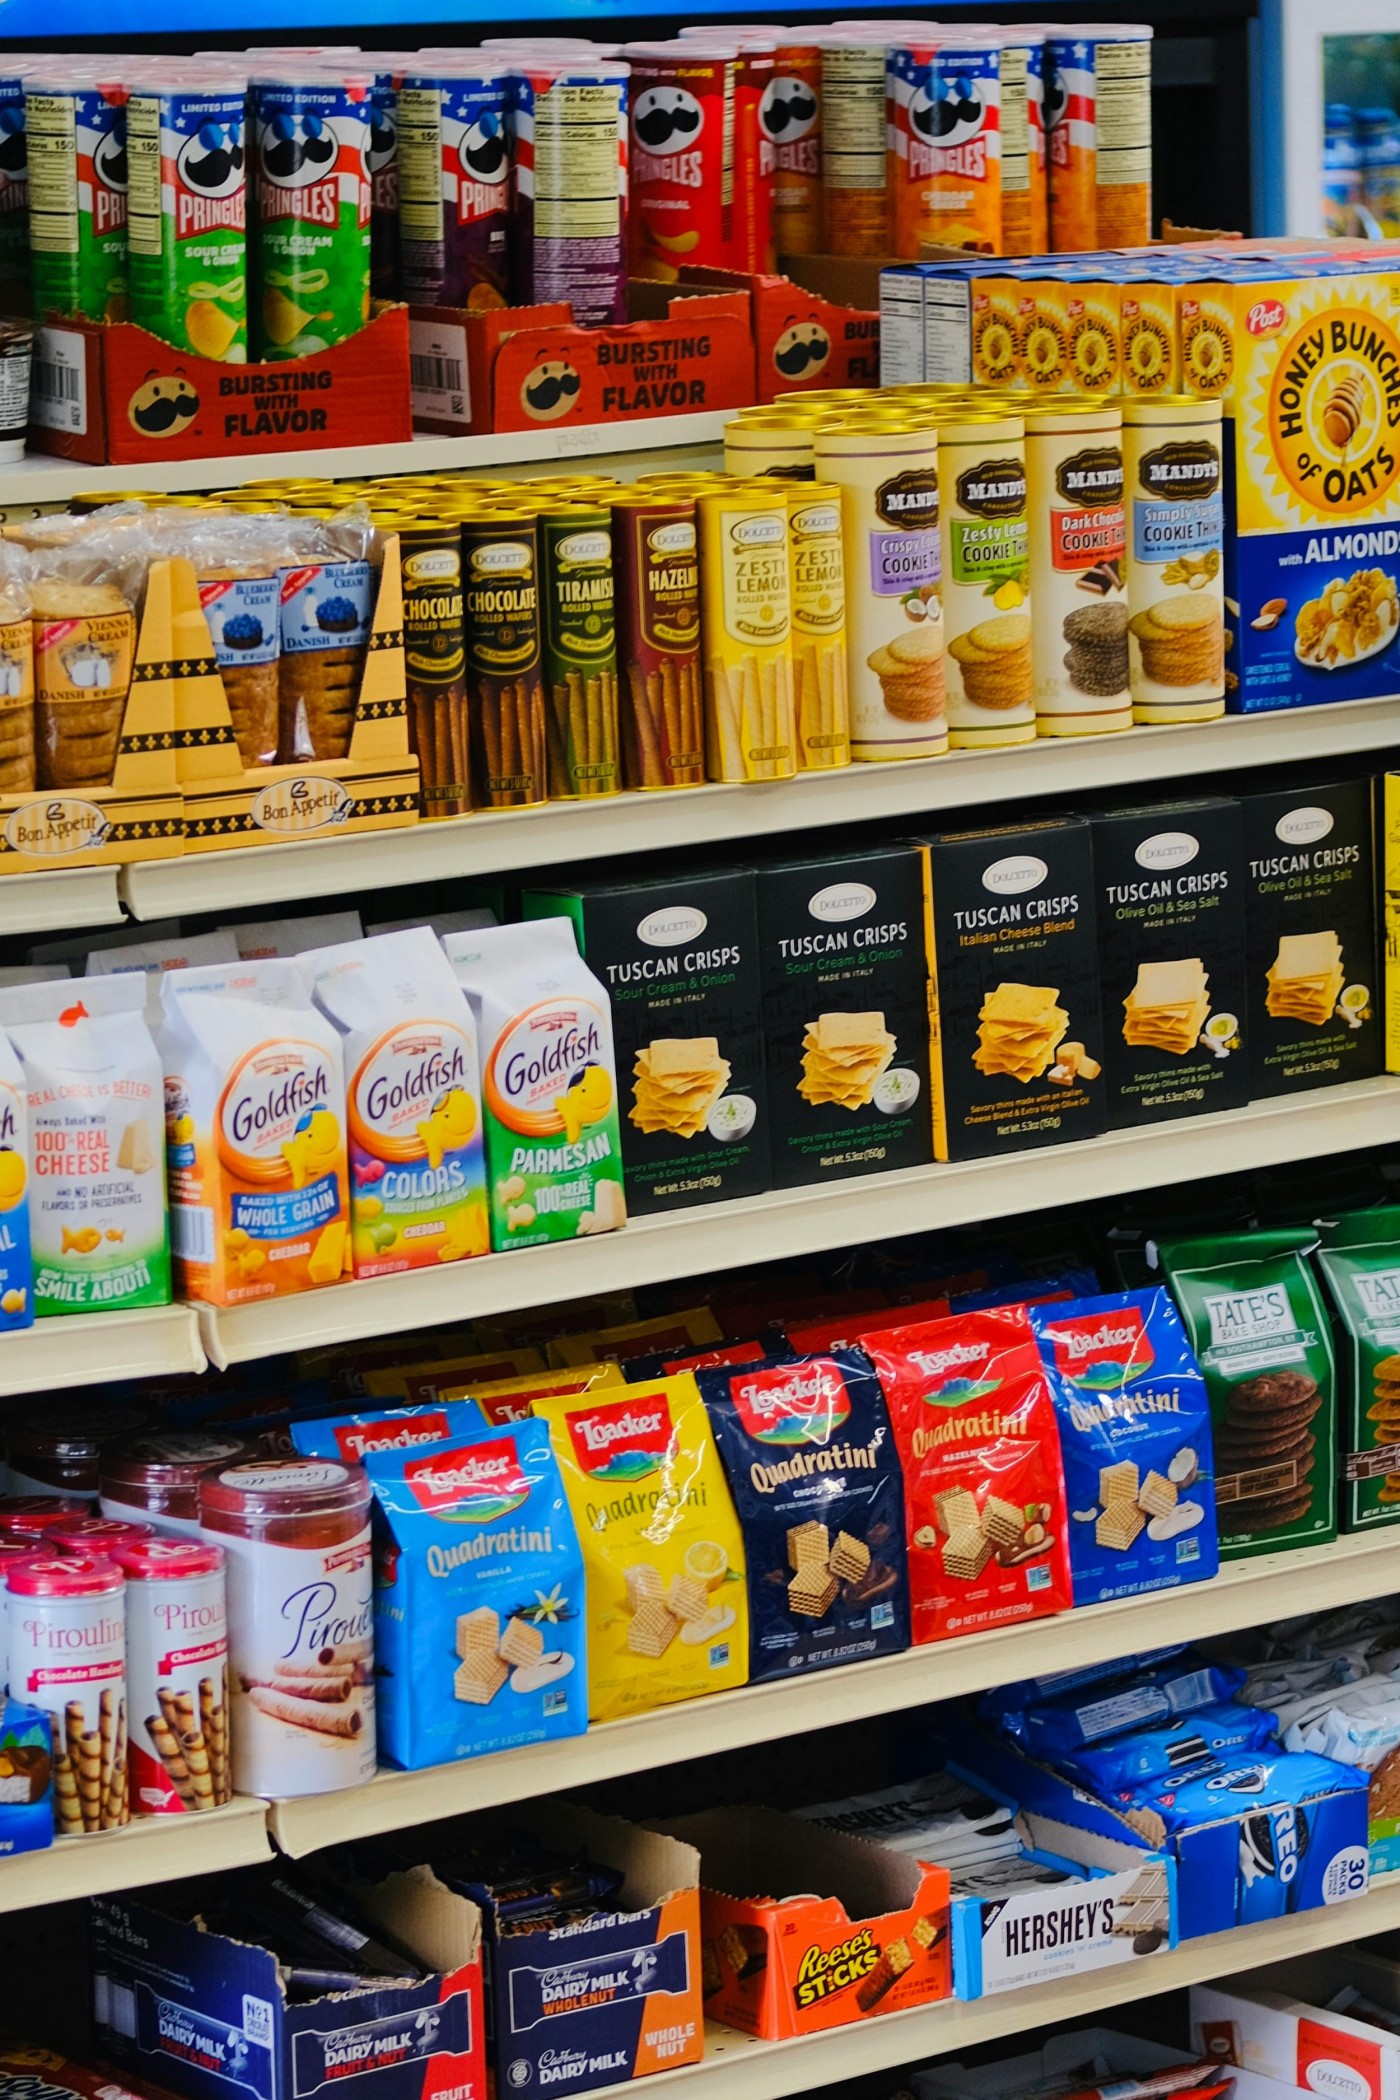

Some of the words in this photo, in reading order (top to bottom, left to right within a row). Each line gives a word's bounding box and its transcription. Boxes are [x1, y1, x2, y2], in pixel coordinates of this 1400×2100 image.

[296, 93, 336, 104] EDITION
[55, 140, 75, 150] 150
[910, 137, 985, 178] PRINGLES
[633, 150, 703, 187] PRINGLES
[261, 184, 338, 226] PRINGLES
[1249, 303, 1282, 331] Post
[597, 336, 711, 367] BURSTING
[218, 371, 333, 396] BURSTING
[633, 362, 678, 381] WITH
[1084, 371, 1112, 388] OATS
[1138, 371, 1166, 389] OATS
[1200, 372, 1227, 389] OATS
[1279, 328, 1325, 439] HONEY
[254, 395, 298, 410] WITH
[603, 380, 706, 412] FLAVOR
[224, 410, 327, 437] FLAVOR
[1323, 444, 1395, 504] OATS
[1061, 513, 1091, 531] Dark
[1144, 506, 1193, 524] Simply
[962, 525, 1001, 544] Zesty
[1062, 531, 1108, 551] COOKIE
[1144, 523, 1193, 543] COOKIE
[881, 538, 919, 556] Crispy
[963, 543, 1010, 563] COOKIE
[1278, 553, 1303, 567] with
[1304, 530, 1400, 564] ALMOND
[882, 554, 928, 575] COOKIE
[243, 594, 271, 605] CREAM
[403, 595, 463, 620] CHOCOLATE
[468, 587, 537, 613] CHOCOLATE
[86, 619, 129, 632] VIENNA
[88, 630, 129, 643] CREAM
[286, 636, 330, 650] DANISH
[40, 690, 85, 700] DANISH
[263, 803, 289, 822] Bon
[290, 791, 341, 816] Appetit
[17, 826, 44, 845] Bon
[46, 815, 97, 839] Appetit
[1249, 853, 1310, 879] TUSCAN
[1313, 844, 1360, 869] CRISPS
[1106, 879, 1171, 905] TUSCAN
[1177, 870, 1228, 897] CRISPS
[1258, 881, 1286, 894] Olive
[1287, 876, 1302, 889] Oil
[1304, 874, 1312, 886] &
[1313, 873, 1332, 885] Sea
[953, 904, 1021, 930] TUSCAN
[1025, 894, 1079, 920] CRISPS
[1115, 904, 1145, 920] Olive
[1147, 902, 1164, 915] Oil
[1165, 900, 1175, 912] &
[1176, 898, 1197, 911] Sea
[1198, 895, 1220, 909] Salt
[778, 929, 848, 958] TUSCAN
[852, 921, 907, 948] CRISPS
[959, 931, 997, 948] Italian
[999, 923, 1041, 942] Cheese
[1043, 917, 1076, 935] Blend
[993, 945, 1015, 954] MADE
[1025, 939, 1047, 949] ITALY
[606, 955, 678, 984] TUSCAN
[684, 945, 741, 972] CRISPS
[785, 959, 814, 975] Sour
[816, 954, 855, 971] Cream
[857, 953, 867, 964] &
[868, 947, 903, 964] Onion
[615, 984, 644, 1001] Sour
[647, 979, 688, 996] Cream
[690, 978, 699, 990] &
[701, 971, 736, 988] Onion
[504, 1021, 600, 1097] Goldfish
[367, 1046, 466, 1121] Goldfish
[529, 1073, 567, 1099] BAKED
[27, 1088, 57, 1108] REAL
[232, 1064, 328, 1142] Goldfish
[391, 1099, 430, 1122] BAKED
[35, 1116, 62, 1128] Always
[64, 1116, 88, 1127] Baked
[255, 1118, 294, 1145] BAKED
[76, 1129, 111, 1151] REAL
[510, 1132, 612, 1174] PARMESAN
[35, 1151, 110, 1176] CHEESE
[56, 1189, 72, 1197] AND
[74, 1186, 88, 1198] NO
[91, 1181, 135, 1197] ARTIFICIAL
[380, 1160, 467, 1201] COLORS
[41, 1199, 76, 1211] FLAVORS
[79, 1198, 88, 1210] OR
[237, 1205, 288, 1227] WHOLE
[292, 1189, 336, 1222] GRAIN
[34, 1276, 88, 1302] SMILE
[1209, 1291, 1286, 1329] TATE'S
[1221, 1326, 1250, 1340] BAKE
[1251, 1319, 1281, 1334] SHOP
[906, 1341, 991, 1377] Loacker
[739, 1374, 834, 1413] Loacker
[574, 1408, 663, 1451] Loacker
[911, 1409, 1028, 1459] Quadratini
[413, 1452, 511, 1496] Loacker
[750, 1442, 878, 1493] Quadratini
[426, 1525, 553, 1579] Quadratini
[476, 1565, 512, 1580] VANILLA
[23, 1619, 123, 1650] Piroulin
[170, 1646, 213, 1667] Chocolate
[1163, 1758, 1227, 1789] OREO
[1271, 1800, 1297, 1884] REO
[1348, 1858, 1366, 1890] 30
[1005, 1897, 1114, 1957] HERSHEY'S
[799, 1928, 873, 1978] Reese's
[1043, 1946, 1075, 1961] cookies
[541, 1966, 589, 1990] Cadbury
[542, 1978, 589, 2003] DAIRY
[590, 1969, 629, 1994] MILK
[159, 2020, 196, 2049] DAIRY
[196, 2034, 226, 2062] MILK
[324, 2031, 373, 2052] Cadbury
[644, 2022, 695, 2047] WHOLE
[198, 2049, 221, 2073] NUT
[324, 2040, 373, 2068] DAIRY
[374, 2031, 412, 2057] MILK
[538, 2048, 586, 2070] Cadbury
[657, 2038, 687, 2058] NUT
[326, 2059, 364, 2080] FRUIT
[366, 2058, 374, 2069] &
[375, 2047, 406, 2068] NUT
[539, 2060, 588, 2085] DAIRY
[589, 2050, 628, 2075] MILK
[430, 2083, 473, 2100] FRUIT
